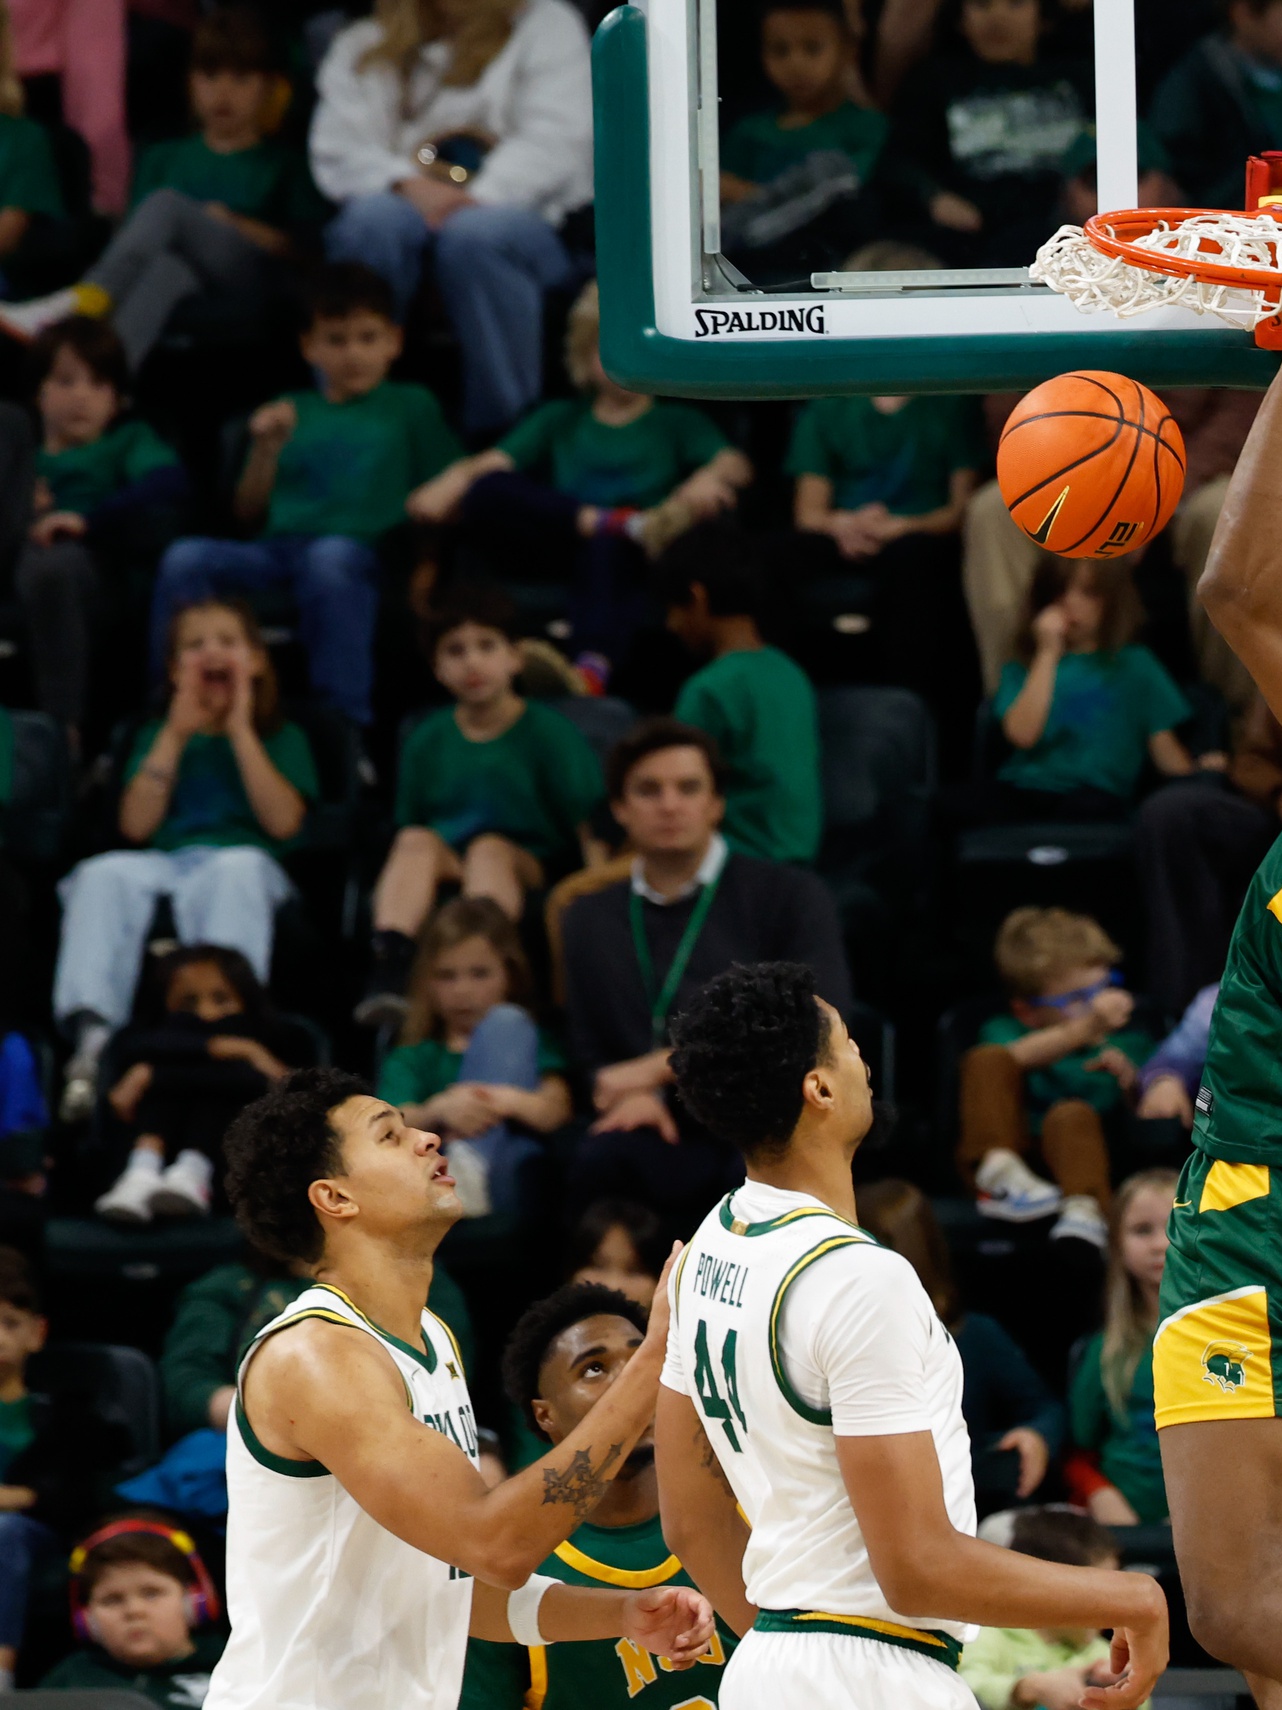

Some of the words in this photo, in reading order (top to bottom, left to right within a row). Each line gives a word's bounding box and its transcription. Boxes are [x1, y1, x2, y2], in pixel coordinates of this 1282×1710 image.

[695, 305, 825, 337] SPALDING
[693, 1252, 749, 1308] POWELL
[694, 1319, 748, 1453] 44
